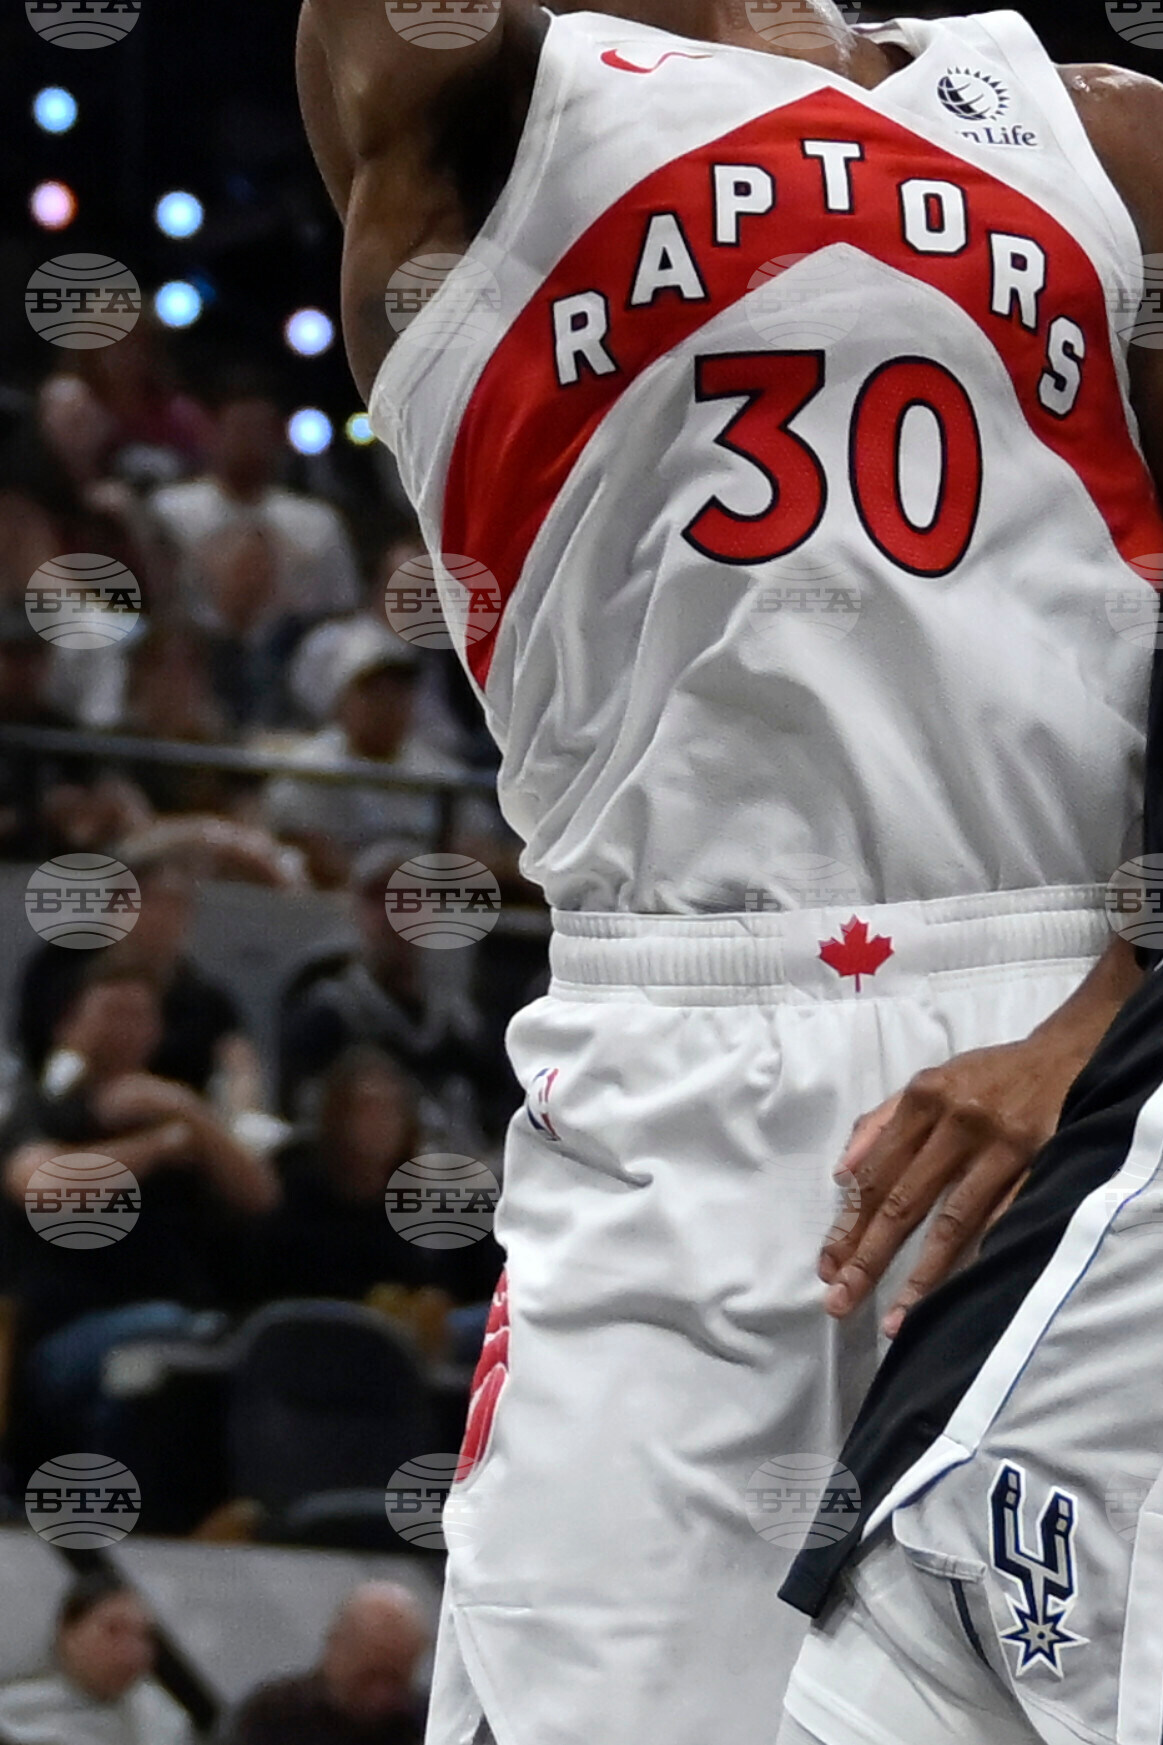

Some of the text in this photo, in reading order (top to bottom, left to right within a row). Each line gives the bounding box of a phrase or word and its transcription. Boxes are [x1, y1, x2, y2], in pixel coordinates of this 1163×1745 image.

[983, 125, 1038, 146] Life
[551, 138, 1086, 422] RAPTORS
[681, 348, 983, 579] 30
